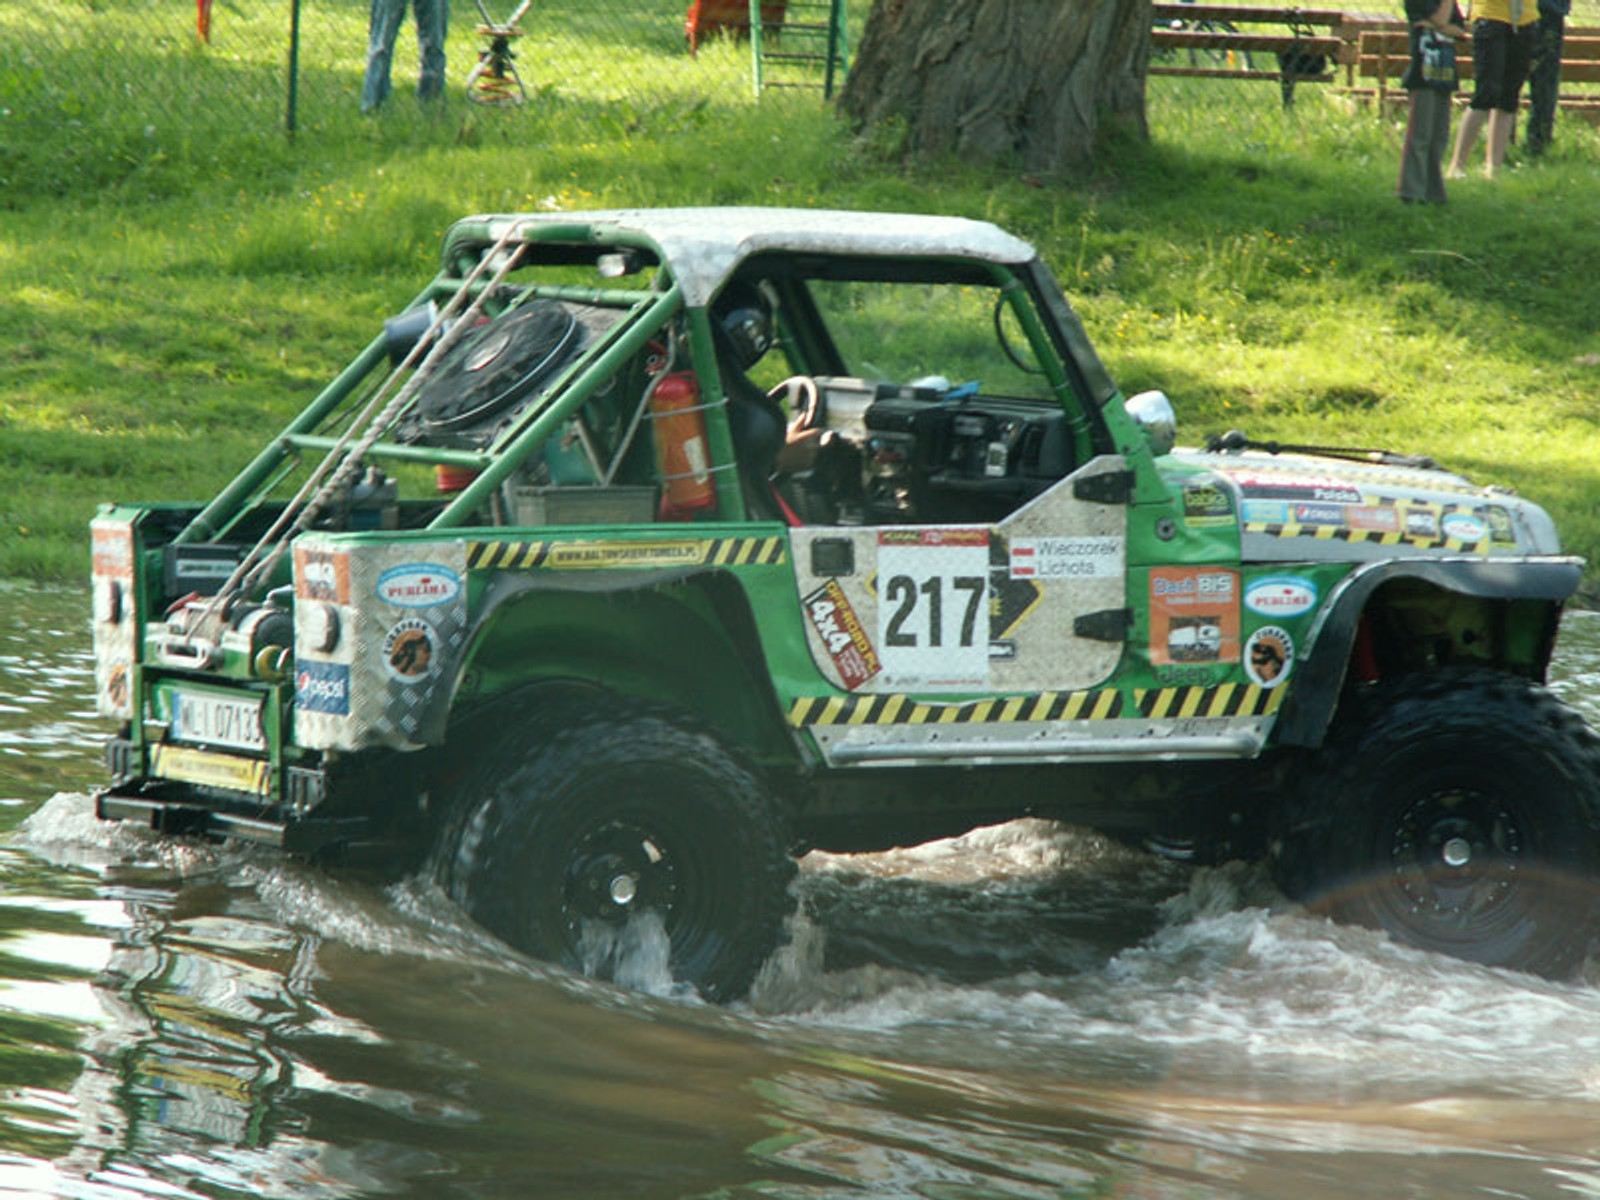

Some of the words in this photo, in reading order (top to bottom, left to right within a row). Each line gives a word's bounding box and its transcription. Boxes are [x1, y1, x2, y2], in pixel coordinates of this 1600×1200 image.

[1039, 542, 1119, 557] Wieczorek
[1039, 560, 1096, 576] Lichota
[886, 575, 984, 648] 217
